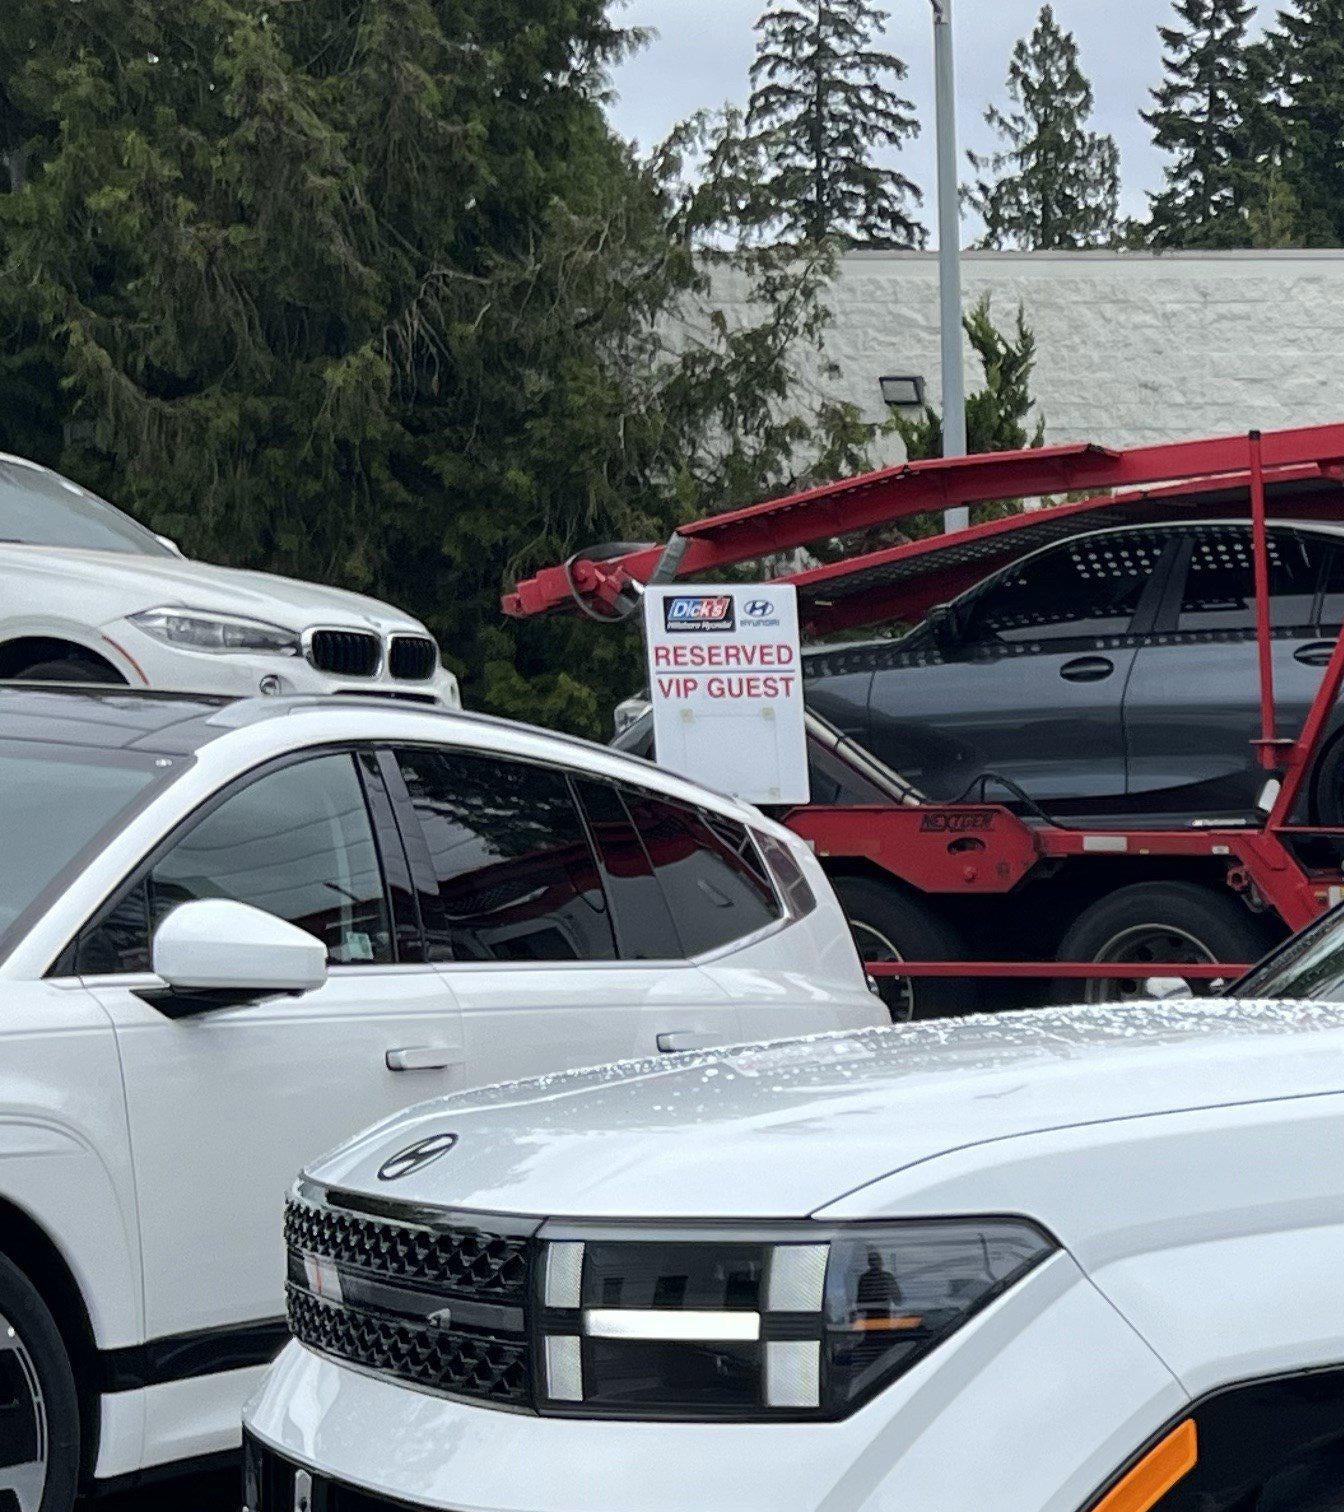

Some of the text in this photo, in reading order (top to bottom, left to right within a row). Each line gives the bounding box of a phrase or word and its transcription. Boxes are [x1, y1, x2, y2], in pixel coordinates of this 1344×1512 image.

[654, 644, 793, 667] RESERVED
[658, 677, 796, 699] VIP GUEST
